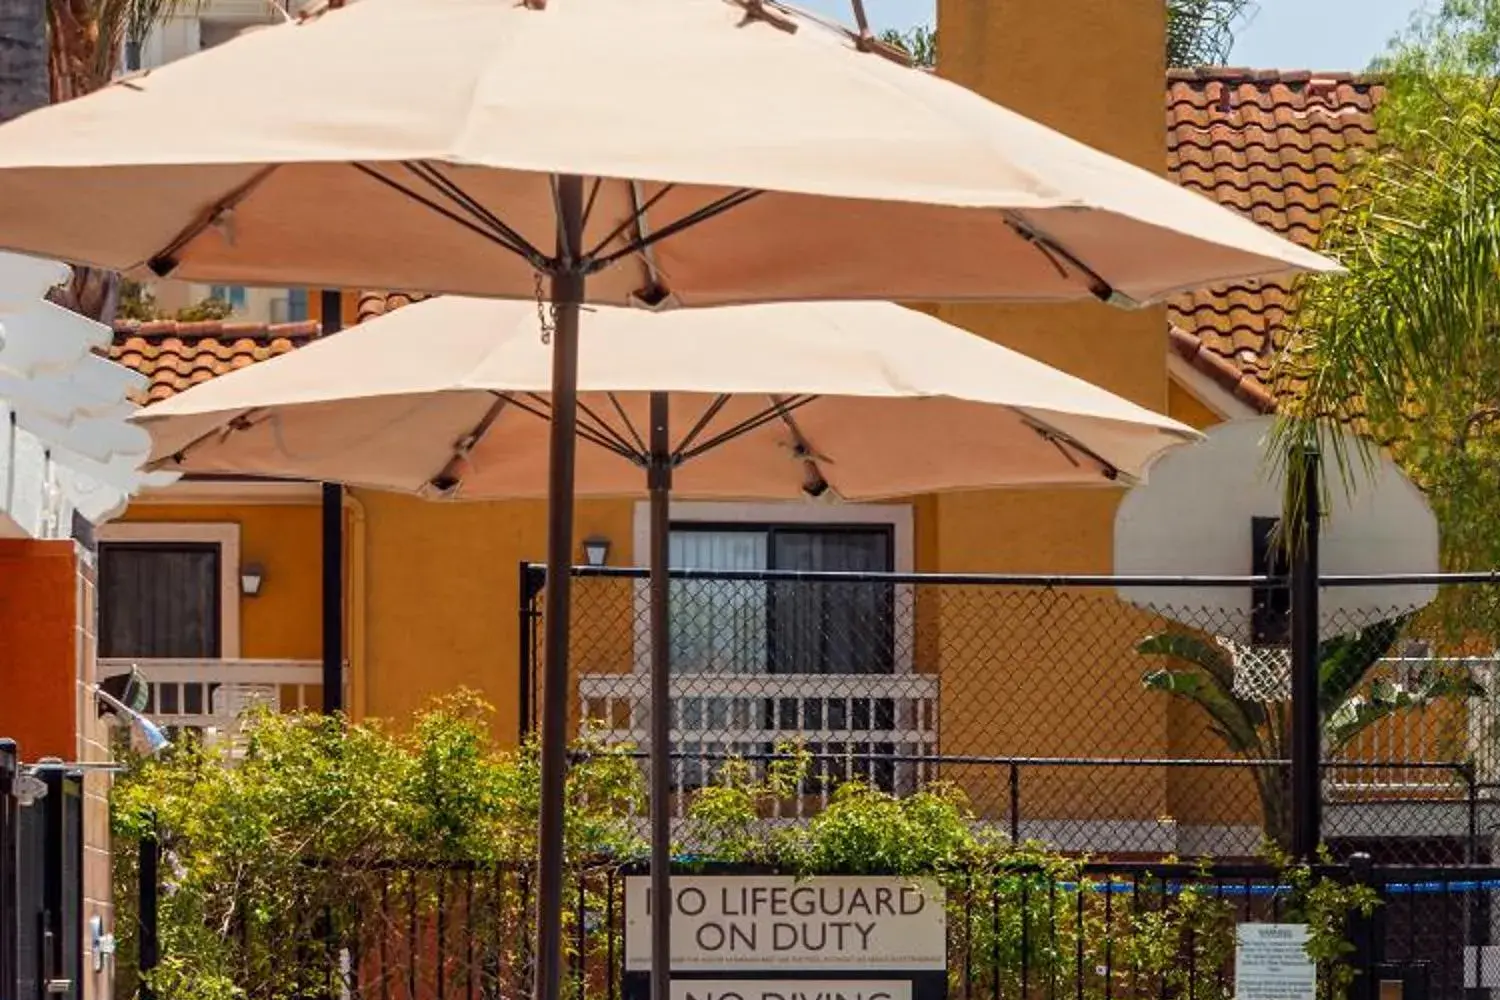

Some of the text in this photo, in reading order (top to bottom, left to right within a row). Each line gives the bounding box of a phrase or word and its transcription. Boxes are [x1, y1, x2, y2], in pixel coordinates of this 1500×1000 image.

[646, 886, 925, 916] O LIFEGUARD
[696, 922, 876, 951] ON DUTY
